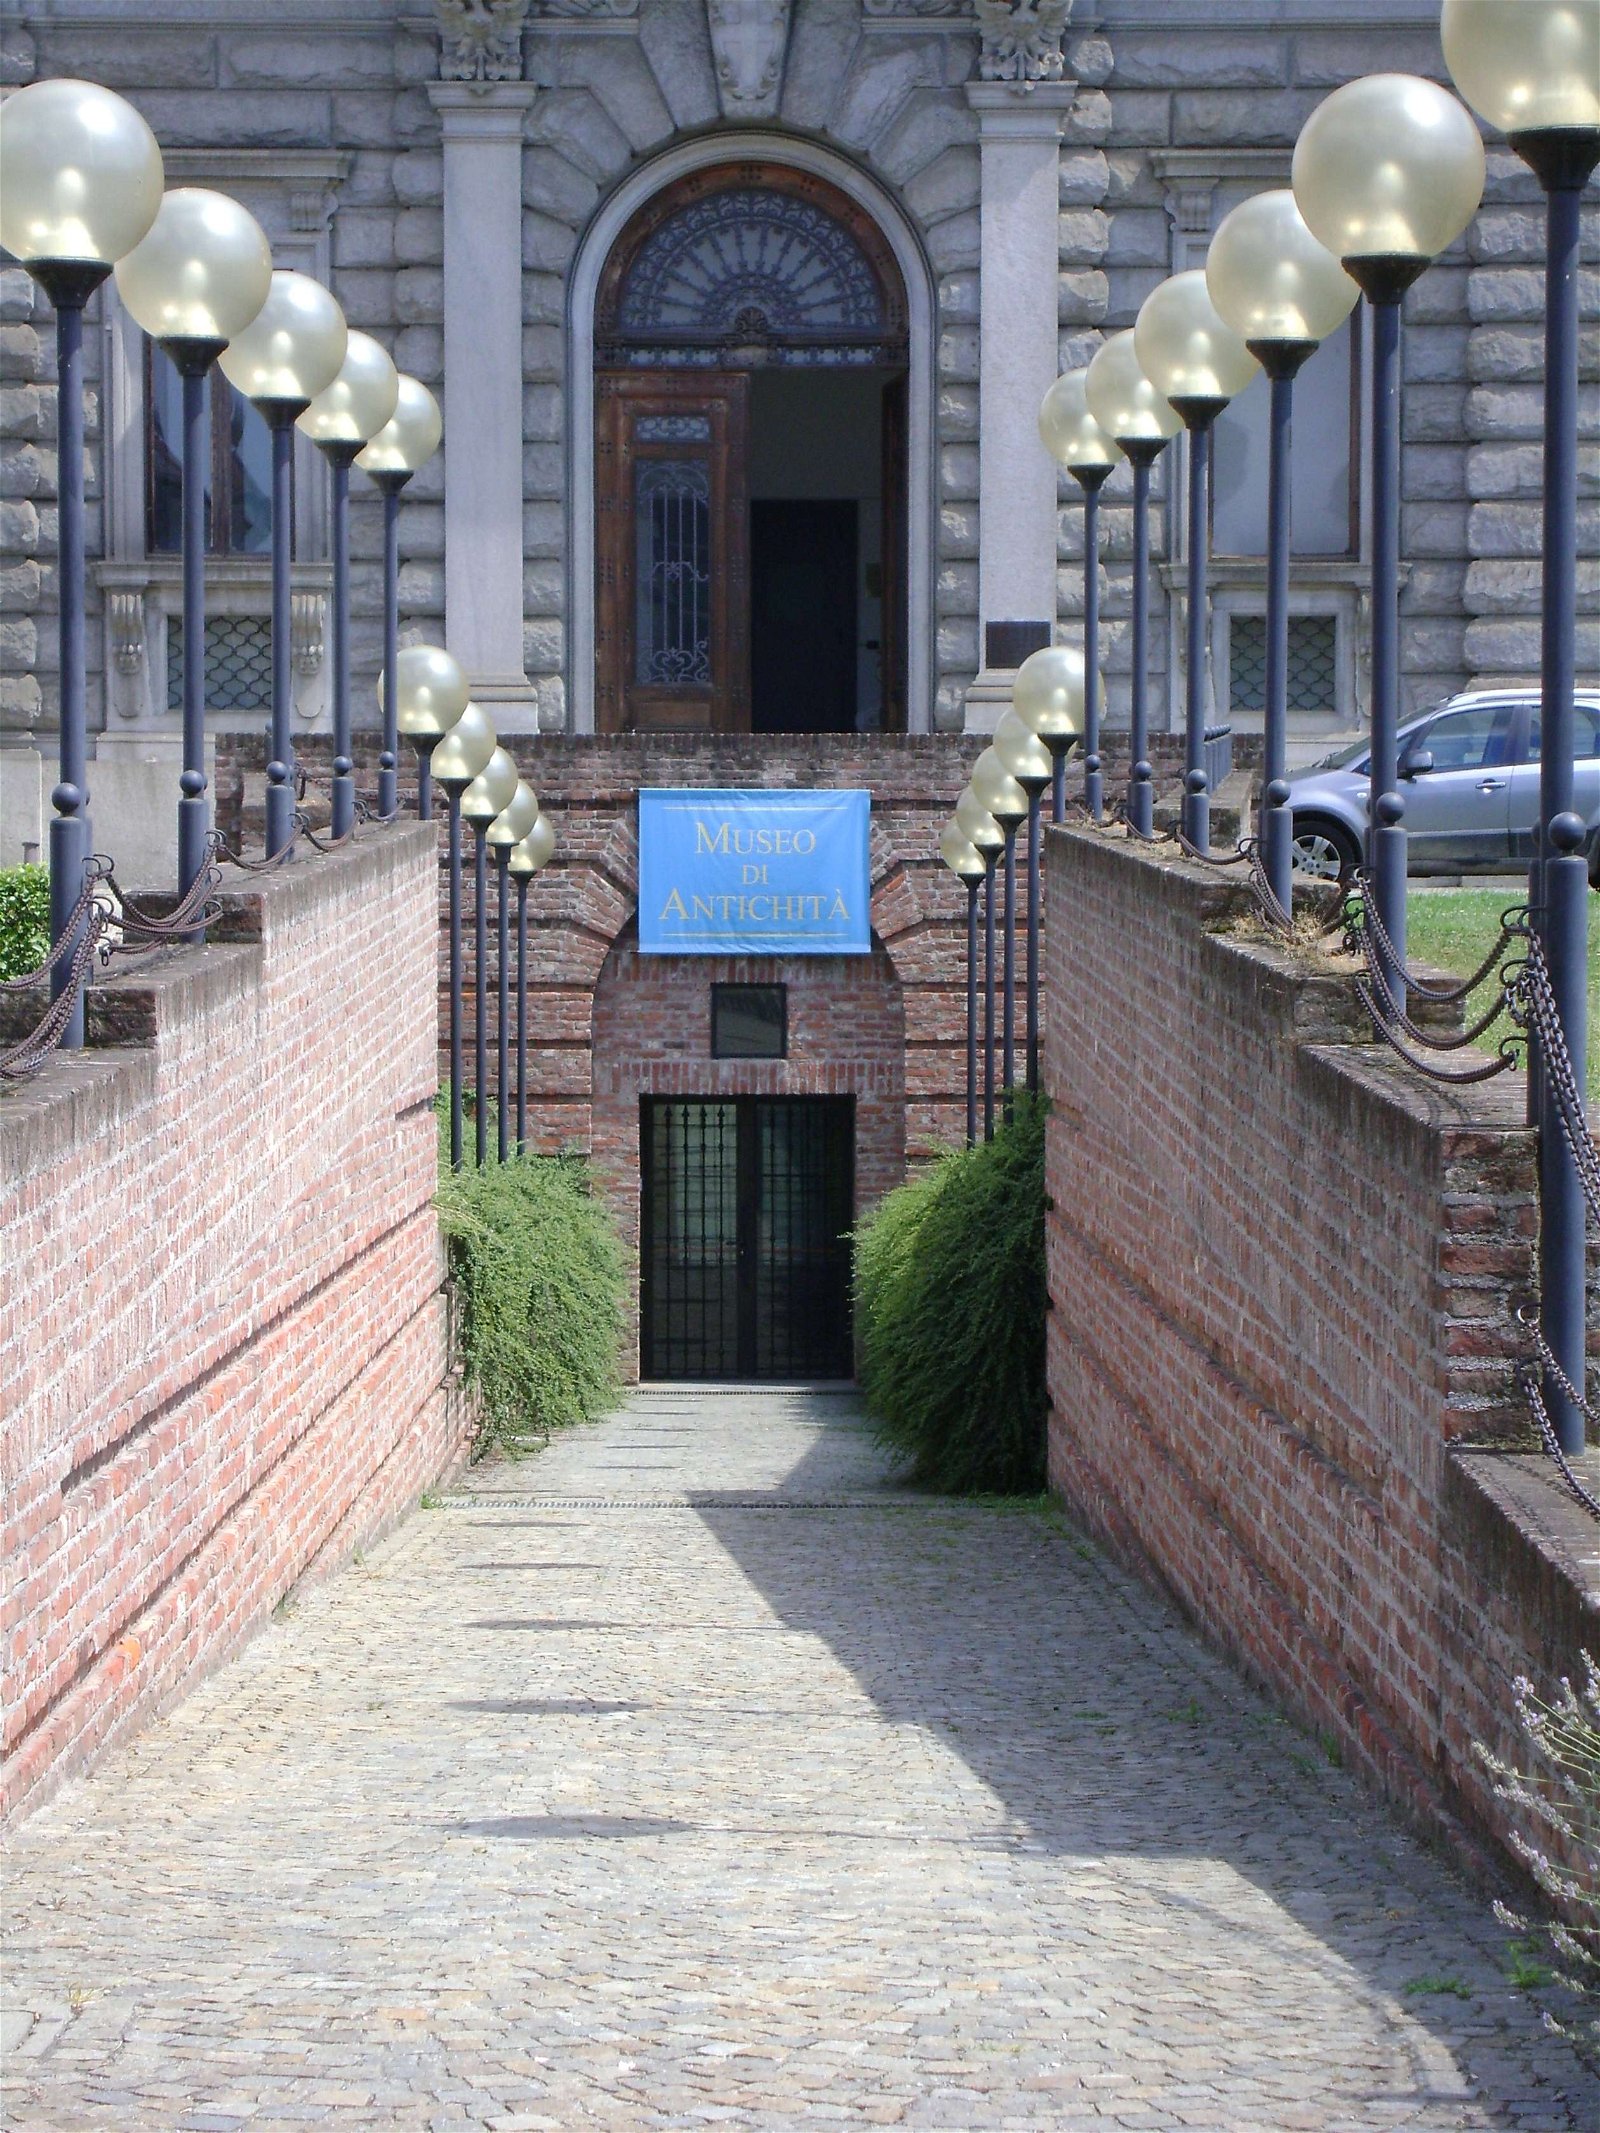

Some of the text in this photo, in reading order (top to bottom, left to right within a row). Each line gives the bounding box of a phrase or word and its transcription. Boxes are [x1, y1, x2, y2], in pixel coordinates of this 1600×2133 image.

[695, 822, 816, 854] MUSEO
[742, 864, 768, 885] DI
[658, 887, 850, 921] ANTICHITÀ
